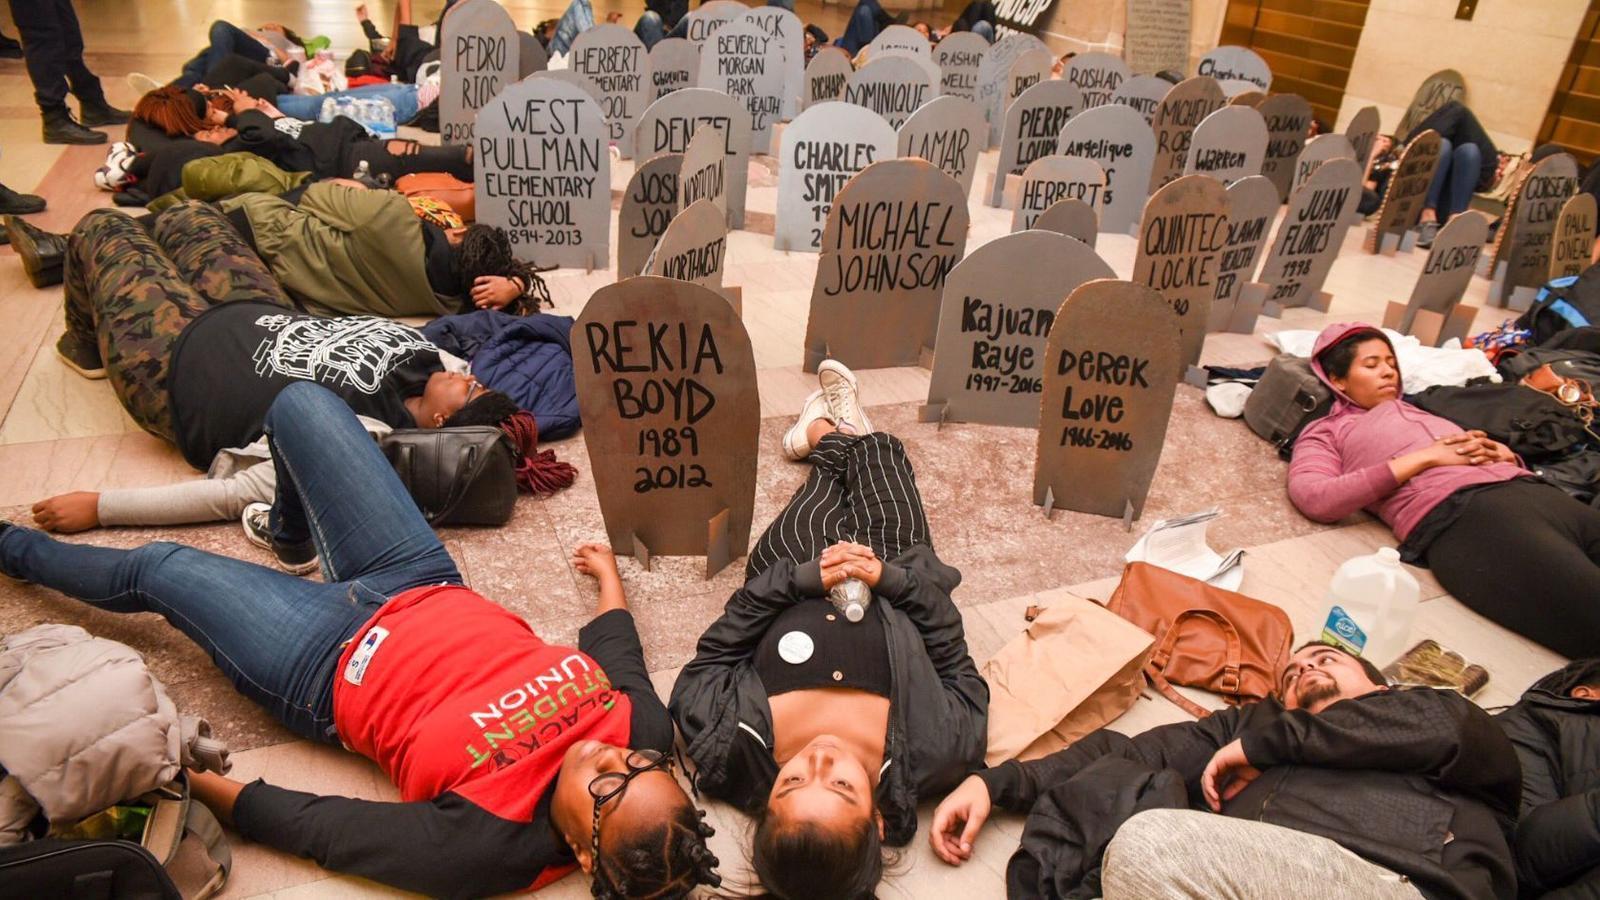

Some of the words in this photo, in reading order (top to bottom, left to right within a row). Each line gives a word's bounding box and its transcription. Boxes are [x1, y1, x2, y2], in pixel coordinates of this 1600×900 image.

[456, 35, 506, 72] PEDRO
[574, 45, 642, 75] HERBERT
[718, 35, 770, 55] BEVERLY
[718, 57, 764, 76] MORGAN
[727, 78, 755, 96] PARK
[811, 72, 847, 101] RICHAR
[845, 83, 929, 115] DOMINIQUE
[502, 98, 586, 136] WEST
[747, 96, 780, 115] HEALTH
[1018, 105, 1073, 139] PIERRE
[1264, 115, 1305, 133] QUAN
[479, 136, 599, 173] PULLMAN
[793, 140, 876, 172] CHARLES
[908, 127, 970, 170] LAMAR
[1064, 139, 1134, 162] Angelique
[485, 172, 596, 199] ELEMENTARY
[802, 172, 852, 204] SMIT
[1021, 179, 1103, 212] HERBERT
[508, 199, 576, 227] SCHOOL
[1298, 187, 1350, 222] JUAN
[507, 228, 583, 247] 1894-2013
[836, 200, 956, 252] MICHAEL
[1278, 222, 1336, 257] FLORES
[1564, 212, 1592, 237] PAUL
[663, 237, 724, 282] NORTHWEST
[823, 252, 957, 297] JOHNSON
[1147, 255, 1215, 292] LOCKE
[1281, 258, 1313, 279] 1998
[1271, 282, 1302, 301] 2017
[960, 296, 1055, 342] Kajuan
[585, 320, 724, 375] REKIA
[971, 341, 1035, 376] Raye
[965, 375, 1043, 394] 1997-2016
[612, 377, 717, 425] BOYD
[637, 426, 699, 458] 1989
[1059, 426, 1133, 451] 1966-2016
[633, 463, 713, 494] 2012
[469, 653, 592, 729] UNION
[465, 667, 613, 770] STUDENT
